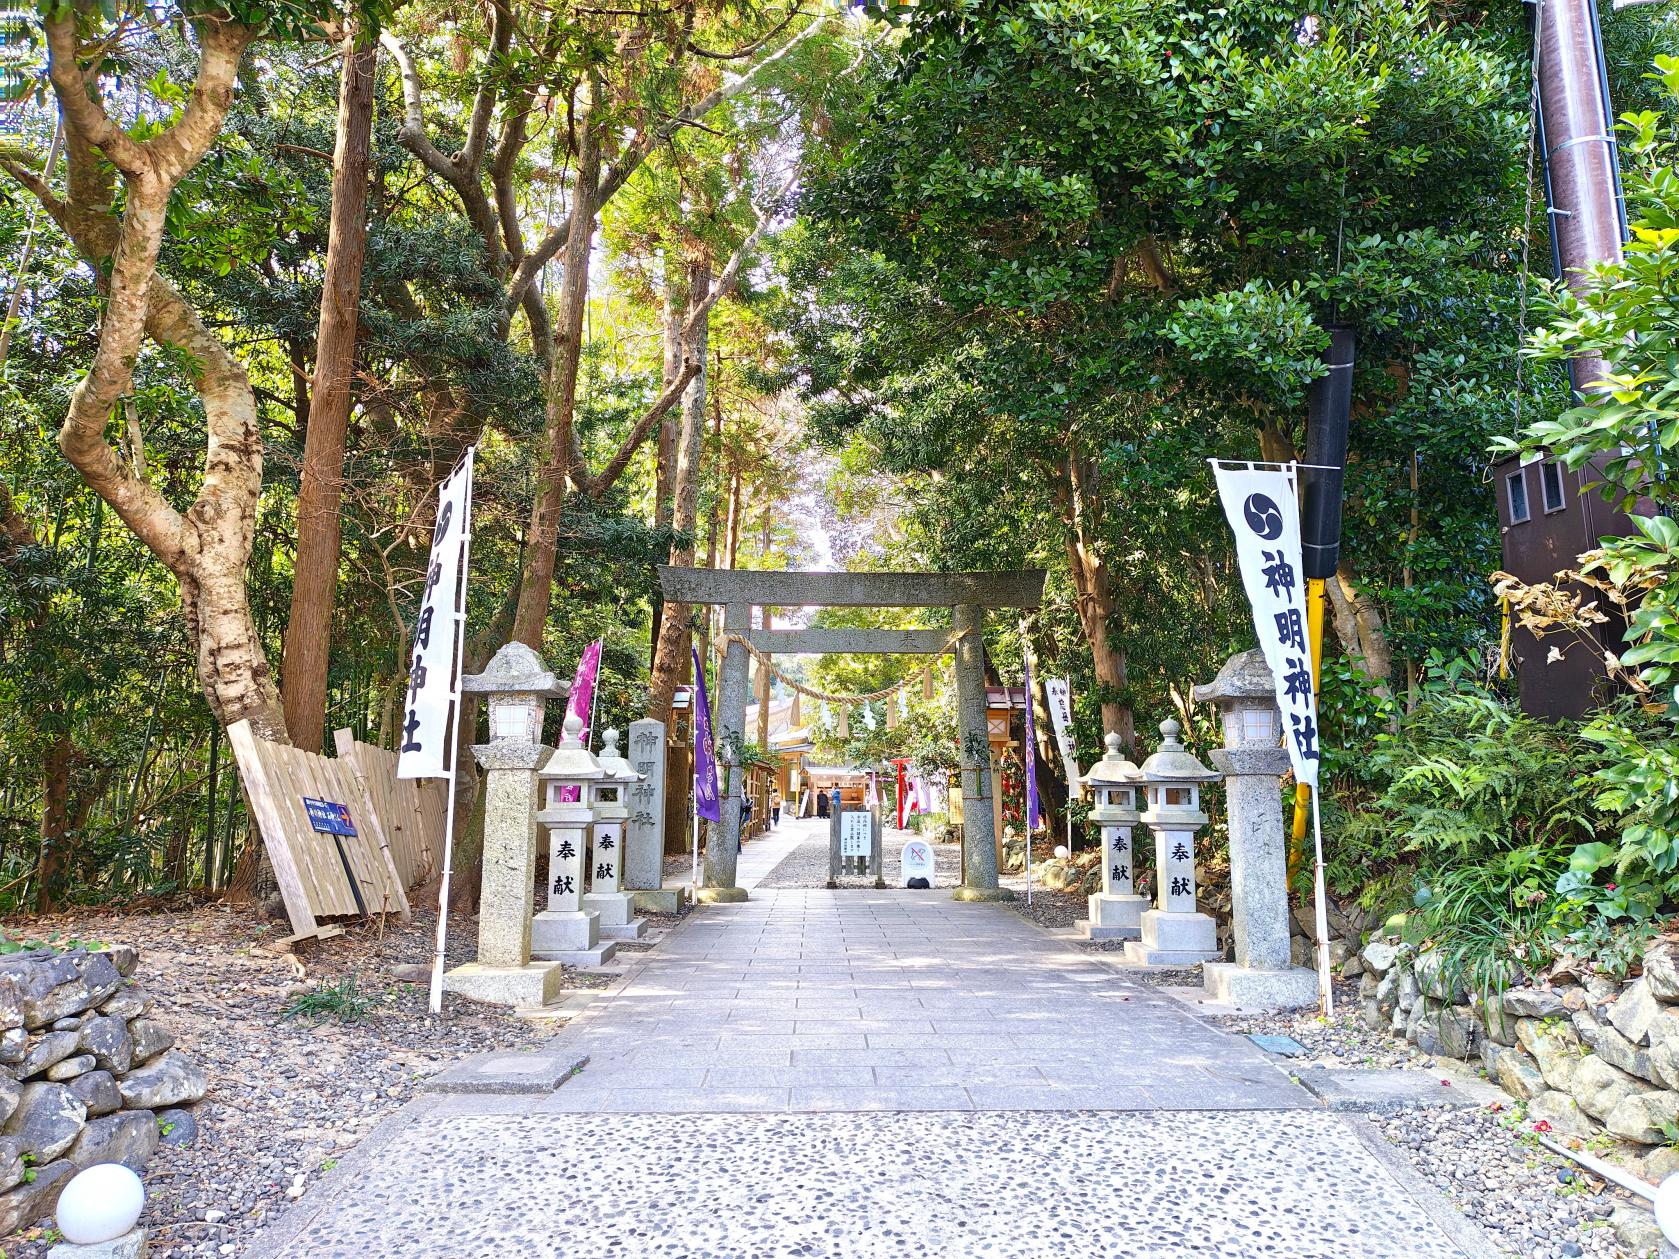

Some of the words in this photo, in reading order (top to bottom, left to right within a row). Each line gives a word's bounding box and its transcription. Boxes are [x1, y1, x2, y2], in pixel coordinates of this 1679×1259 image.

[1261, 549, 1319, 761] 神明神社
[631, 731, 659, 832] 神明神社
[553, 840, 576, 895] 奉献
[596, 833, 615, 879] 奉献
[1112, 836, 1130, 882] 奉献
[1171, 842, 1192, 897] 奉献
